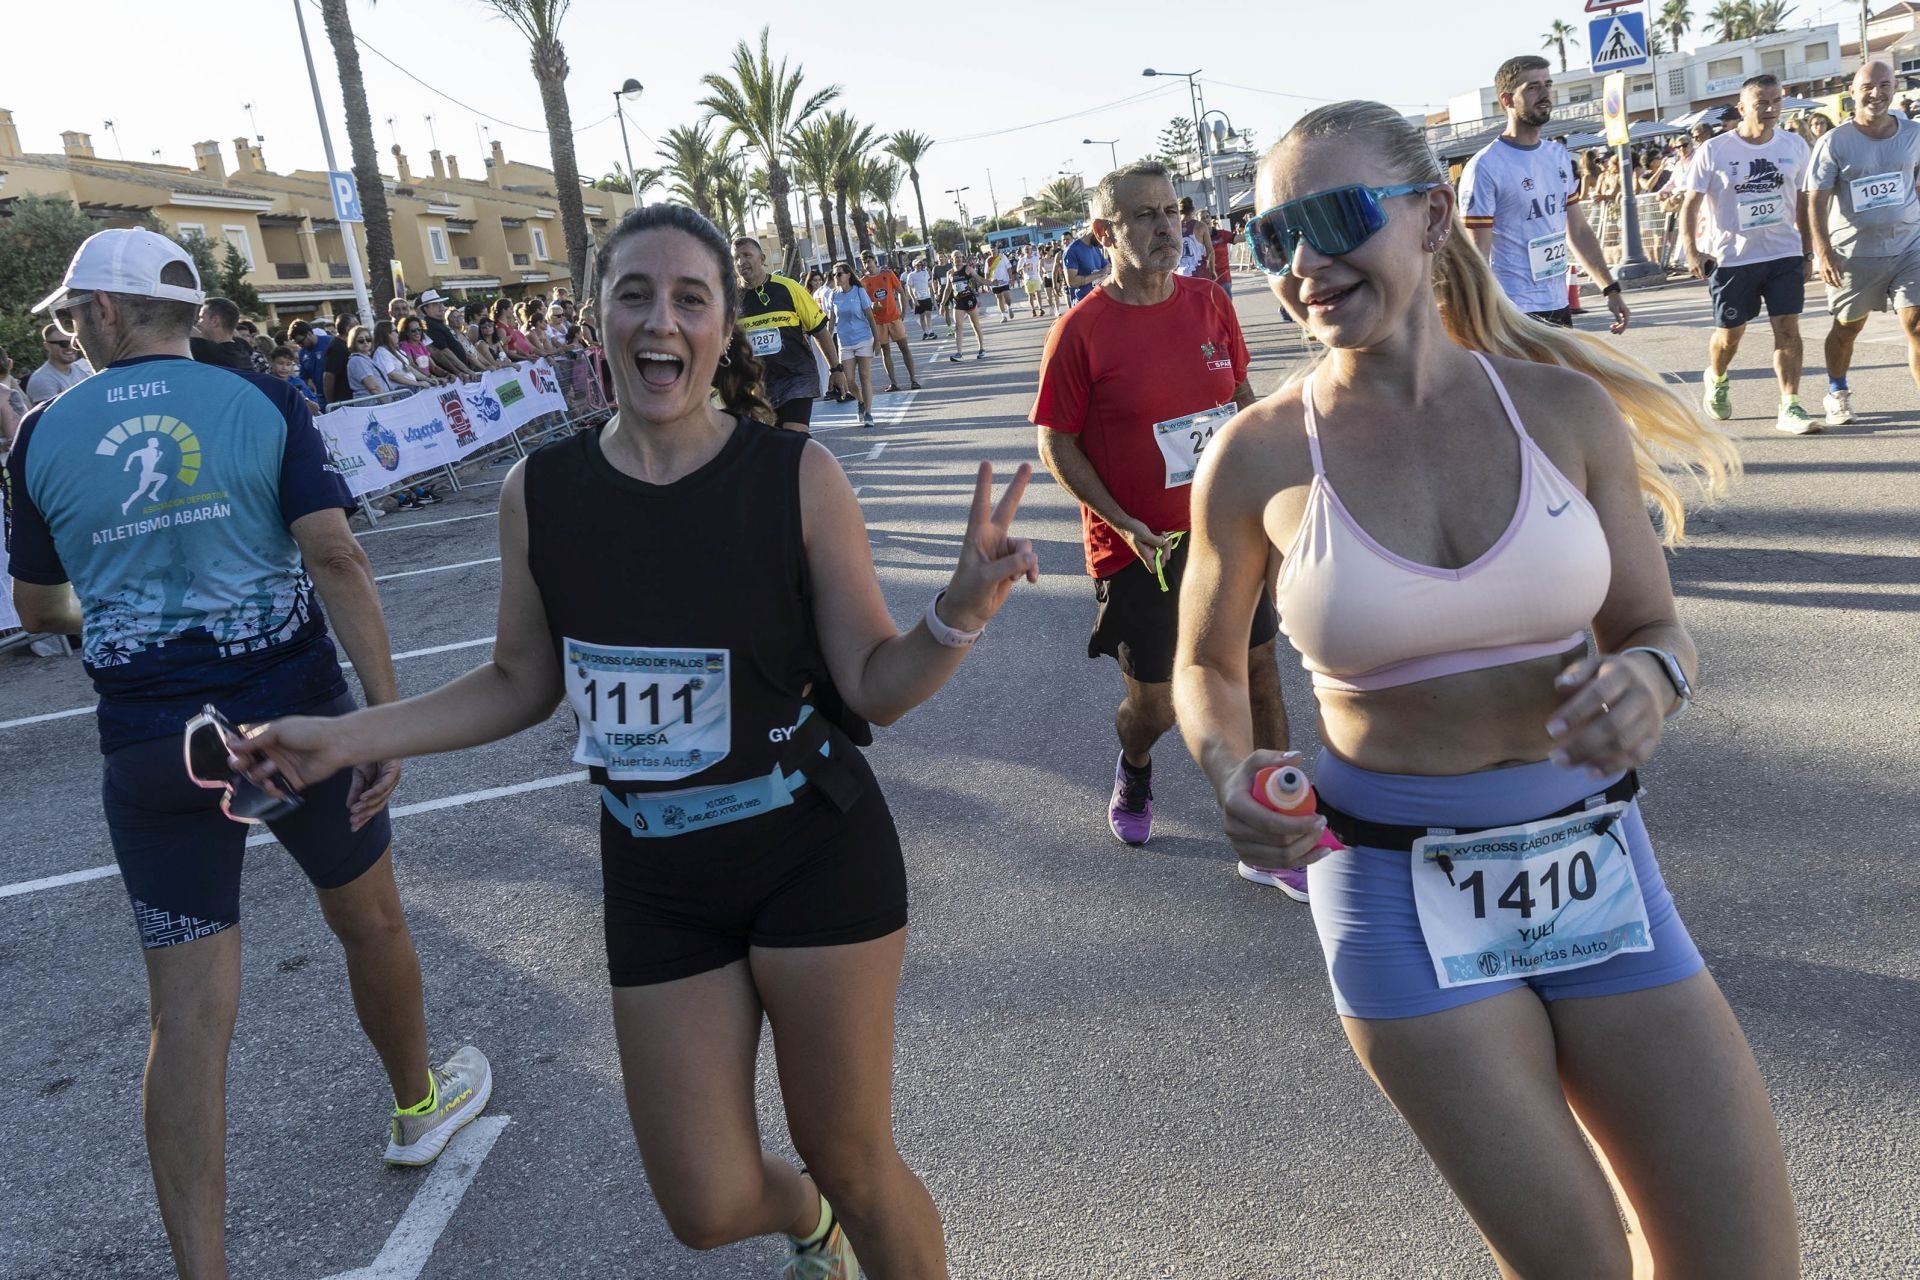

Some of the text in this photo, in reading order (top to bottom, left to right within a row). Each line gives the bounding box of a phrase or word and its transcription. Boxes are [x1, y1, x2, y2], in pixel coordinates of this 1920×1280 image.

[334, 177, 353, 216] P
[1862, 182, 1897, 198] 1032
[1751, 203, 1775, 216] 203
[752, 334, 775, 346] 1287
[92, 503, 231, 545] ATLETISMO ABARÁN
[591, 654, 621, 666] CROSS
[622, 657, 652, 667] CABO
[654, 658, 668, 668] DE
[670, 659, 704, 668] PALOS
[584, 679, 693, 725] 1111
[604, 732, 669, 746] TERESA
[768, 725, 797, 743] GY
[611, 756, 692, 768] Huertas Auto
[1454, 820, 1599, 856] XV CROSS CABO DE PALOS
[1459, 850, 1598, 919] 1410
[1517, 921, 1555, 943] YULI
[1478, 939, 1608, 976] MG Huertas Auto
